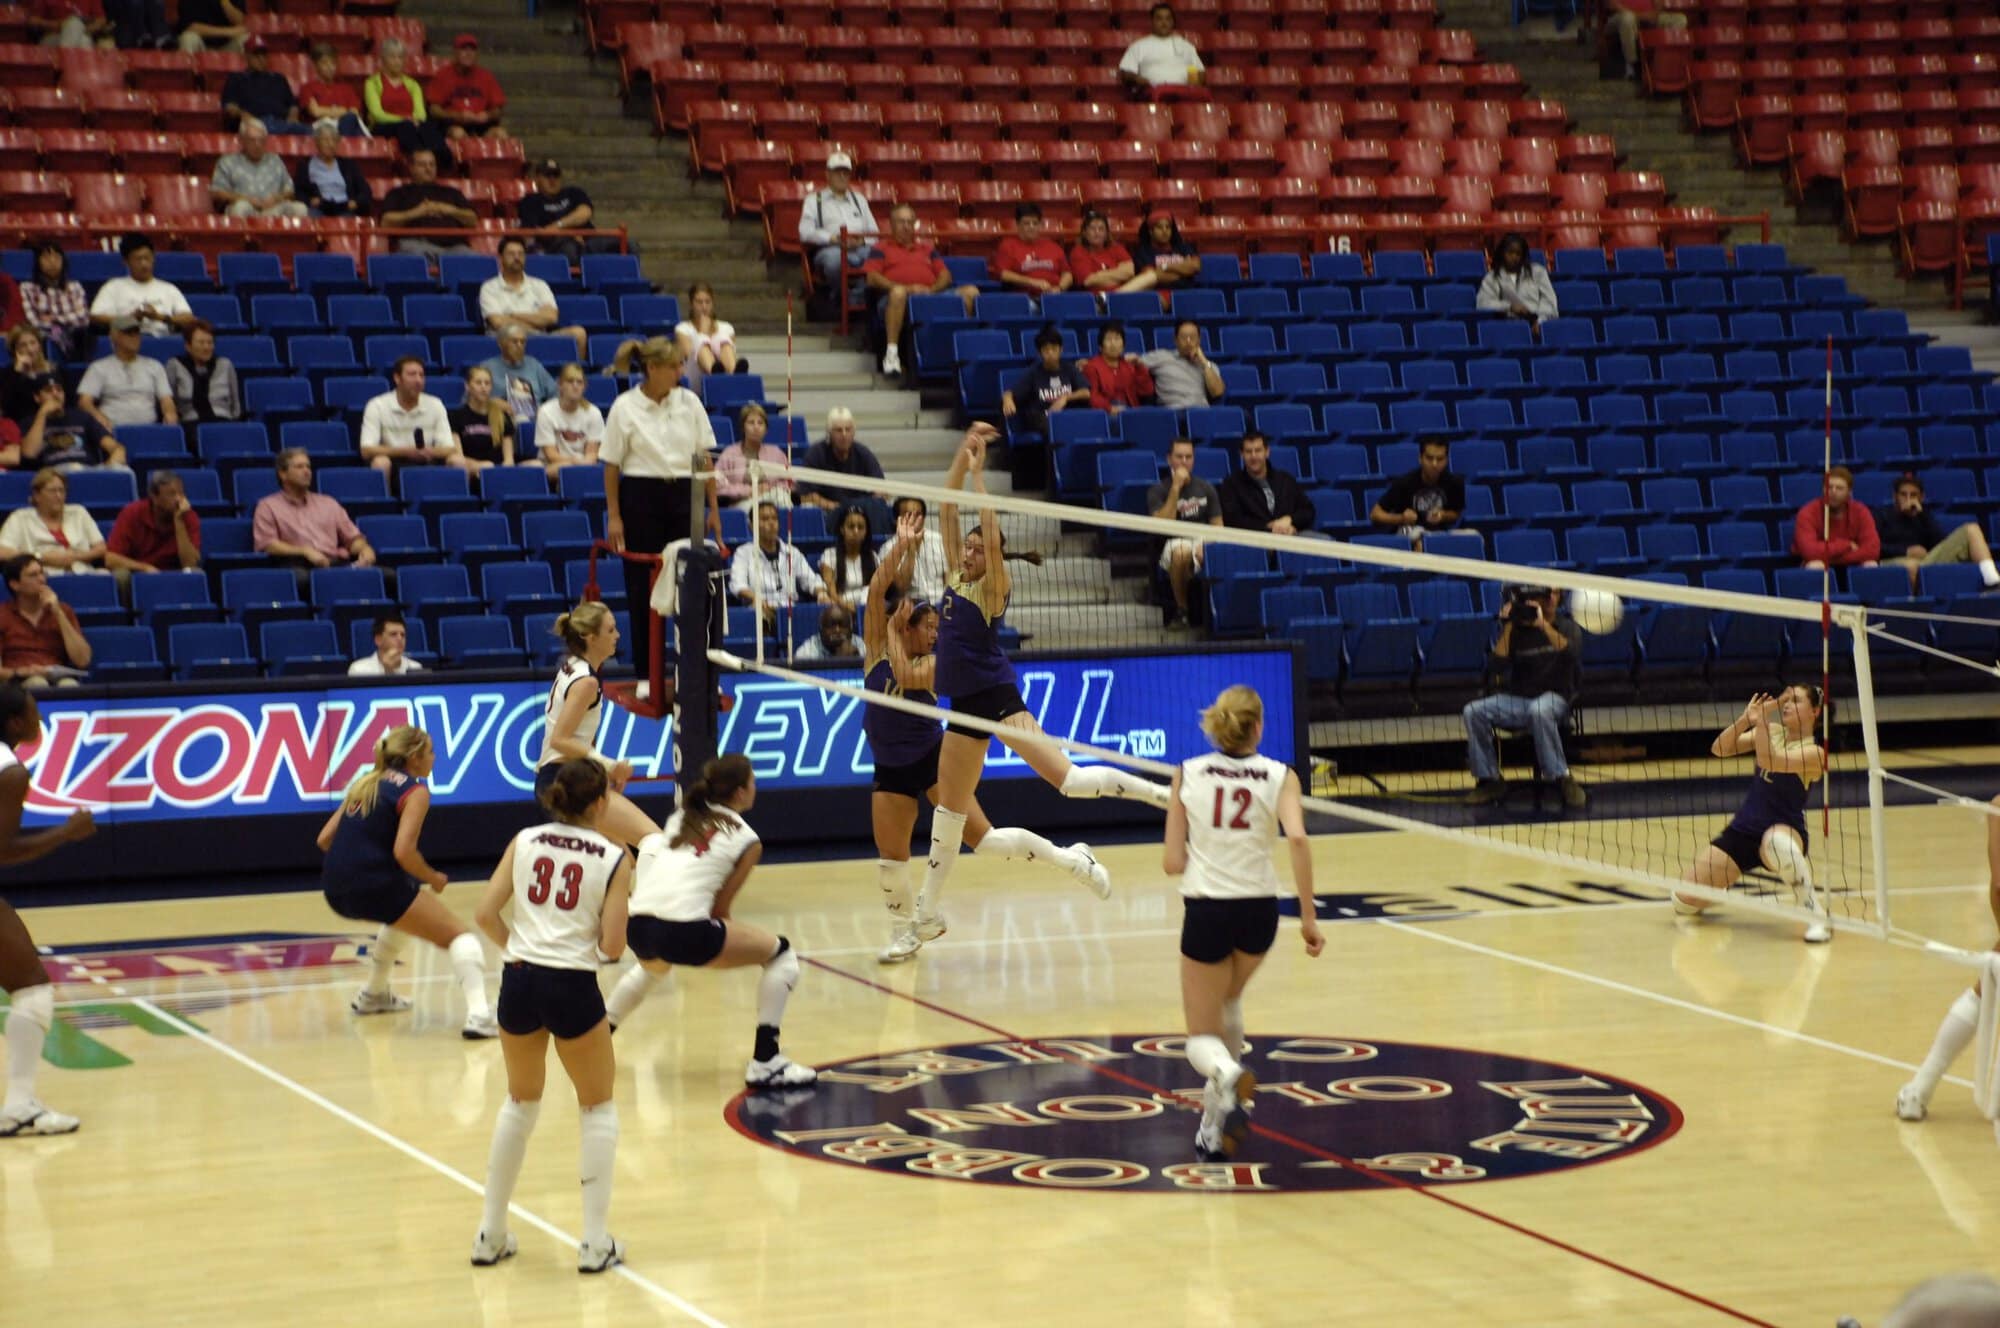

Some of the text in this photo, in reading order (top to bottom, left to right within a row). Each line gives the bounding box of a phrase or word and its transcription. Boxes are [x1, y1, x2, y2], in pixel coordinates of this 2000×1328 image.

[1212, 786, 1252, 829] 12
[527, 855, 584, 912] 33
[1469, 1074, 1655, 1160] LUTE
[773, 1121, 1279, 1189] BOBBI
